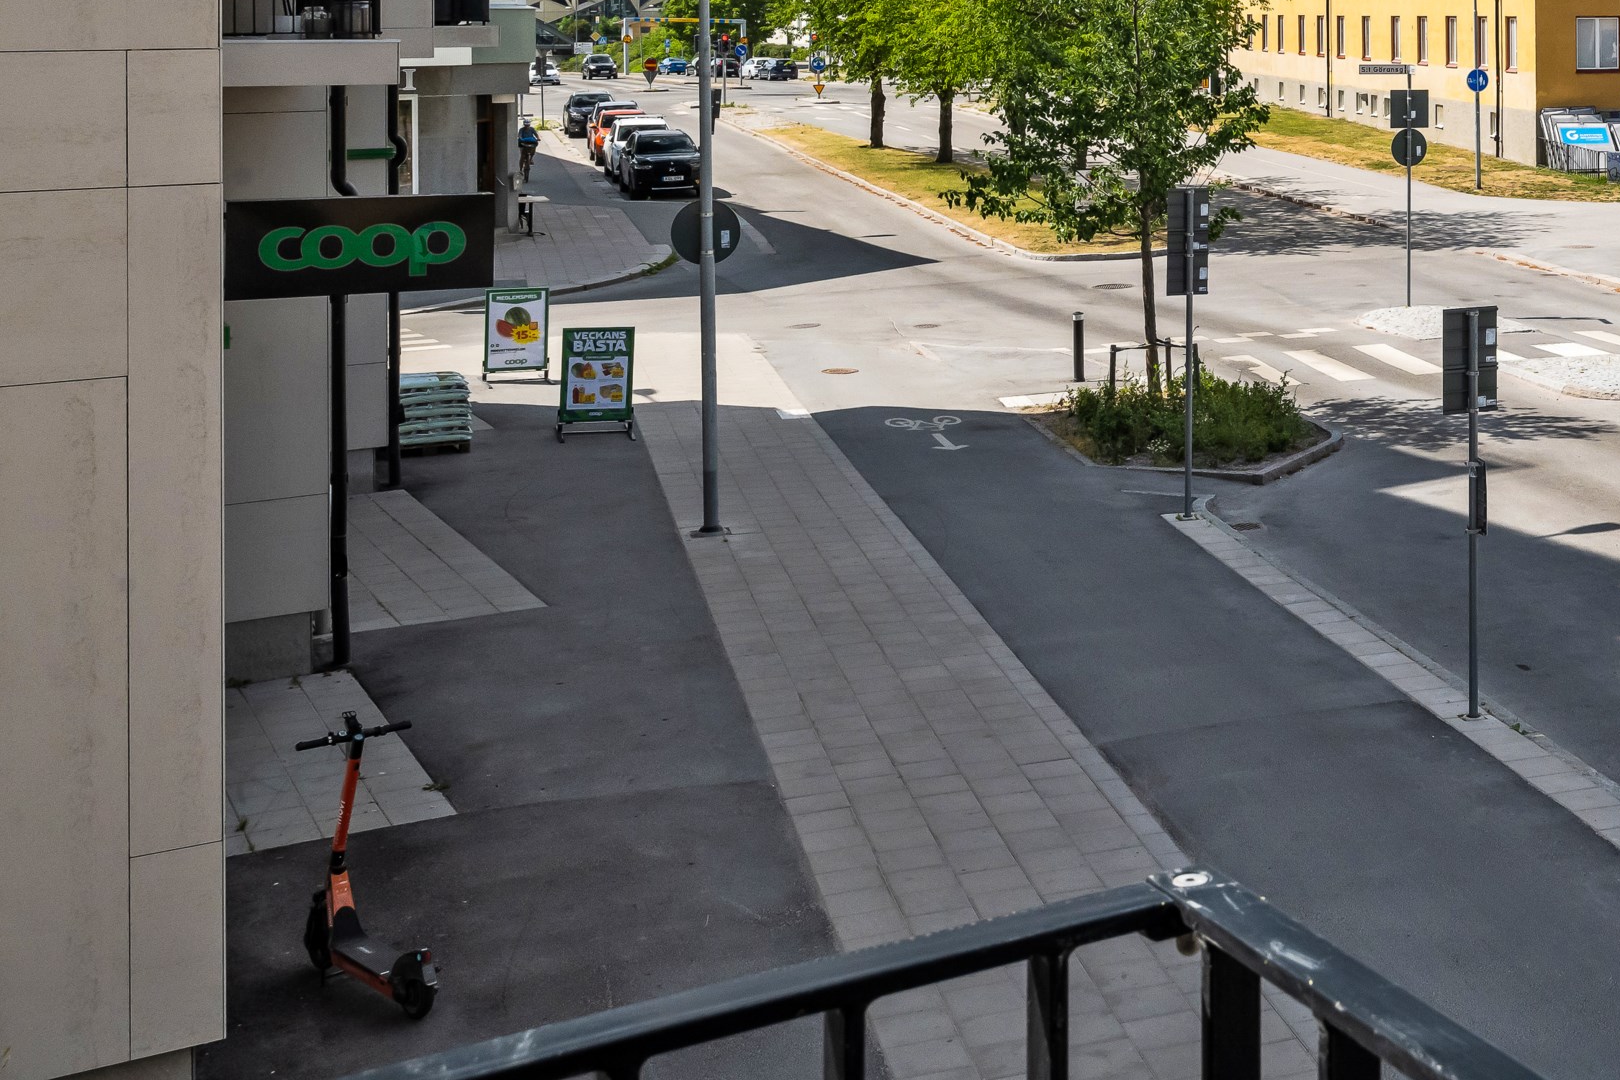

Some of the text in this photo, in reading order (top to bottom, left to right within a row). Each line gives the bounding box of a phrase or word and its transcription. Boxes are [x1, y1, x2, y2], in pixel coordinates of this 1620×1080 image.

[258, 221, 467, 277] coop
[573, 331, 627, 339] VECKANS
[573, 339, 627, 352] BÄSTA
